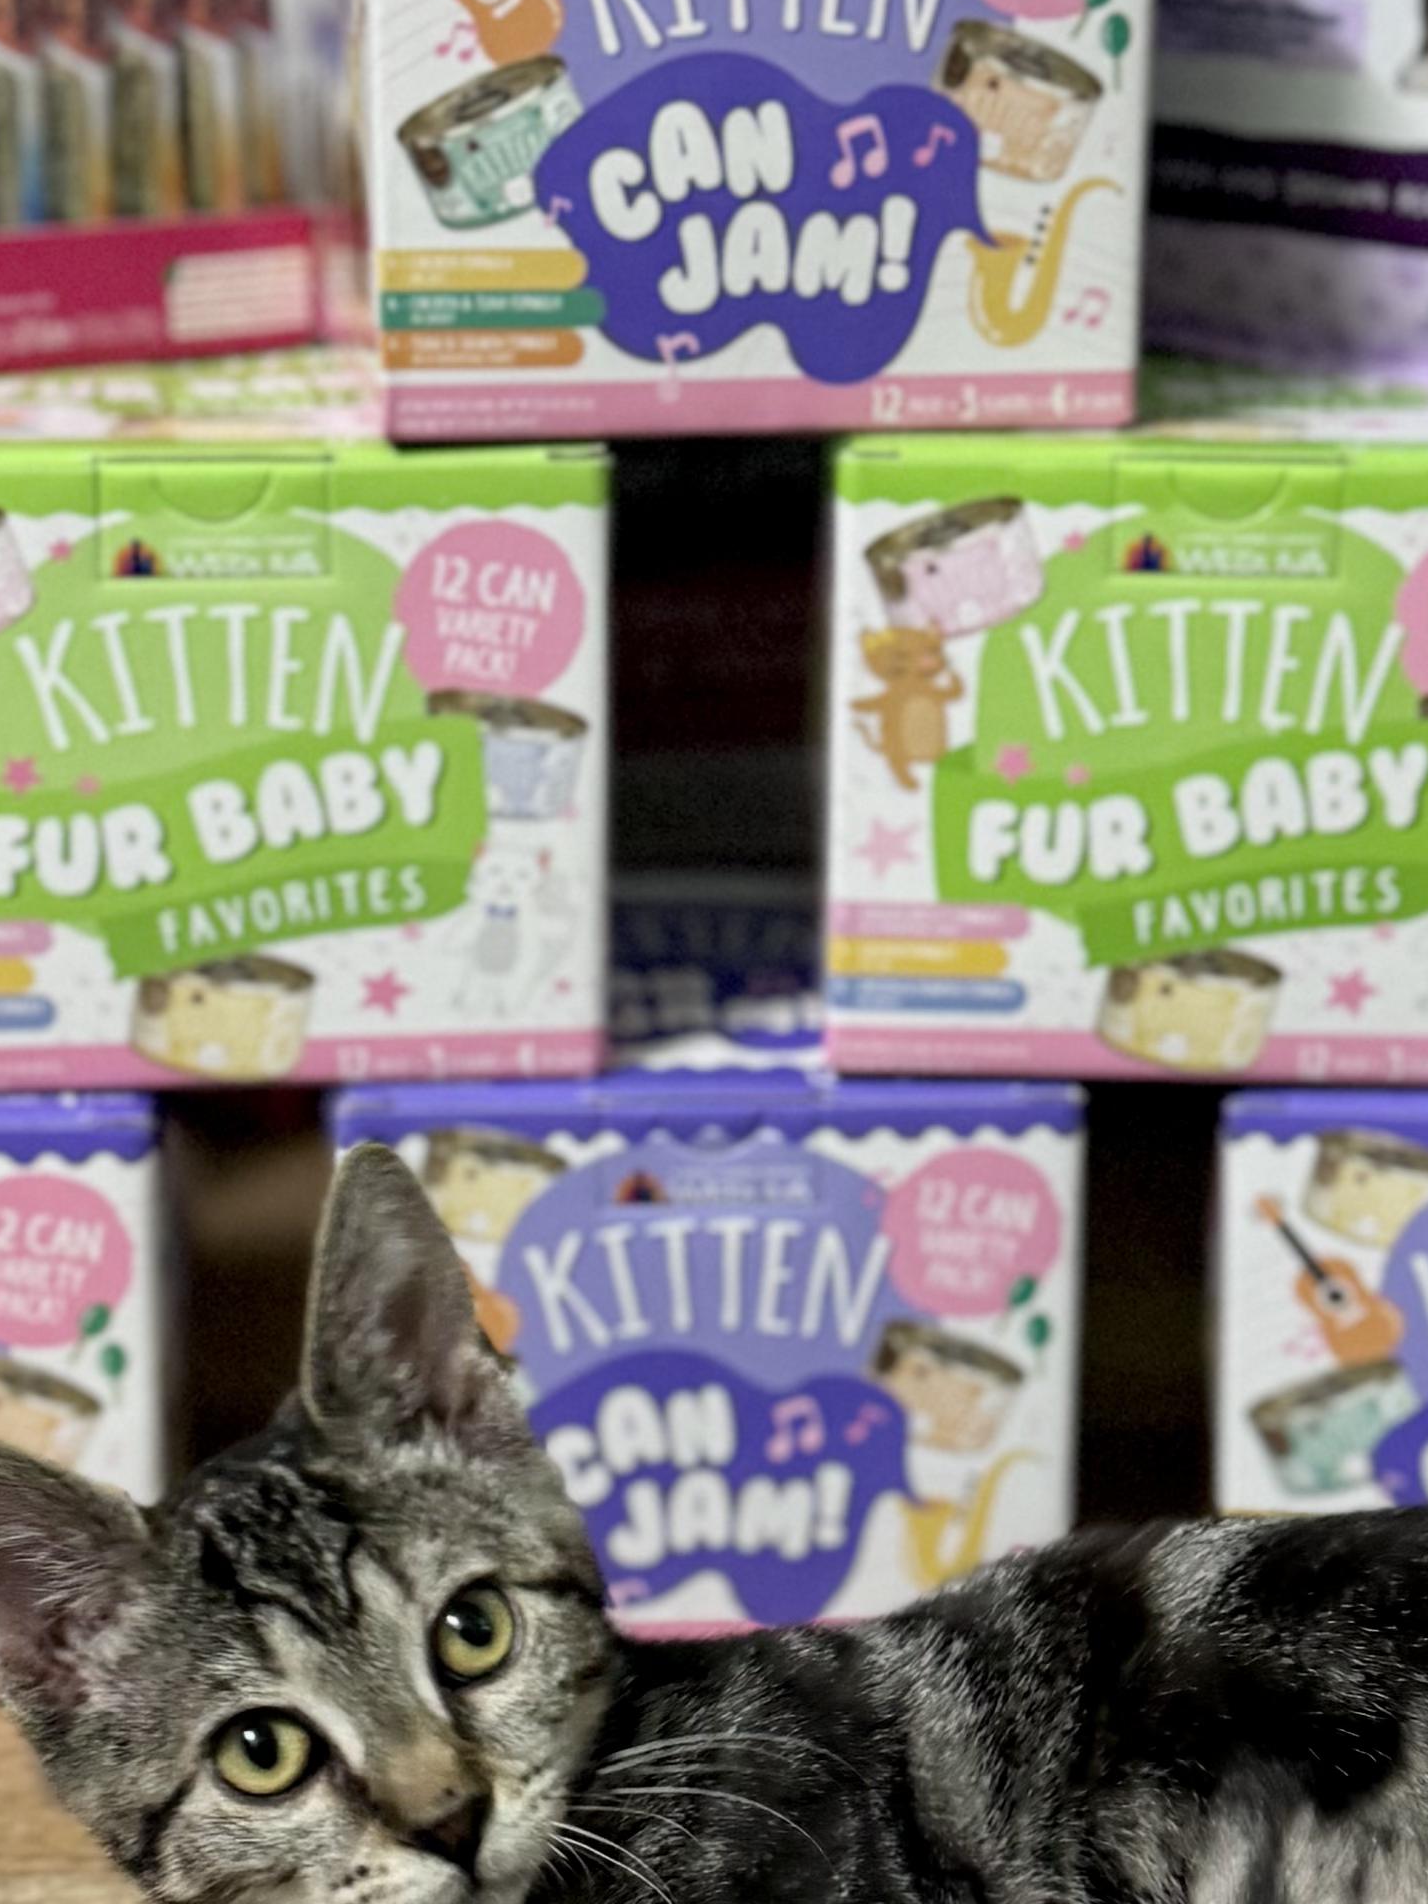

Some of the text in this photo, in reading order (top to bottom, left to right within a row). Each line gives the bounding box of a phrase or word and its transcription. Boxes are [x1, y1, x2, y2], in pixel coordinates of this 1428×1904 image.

[588, 99, 794, 241] CAN
[658, 194, 918, 314] JAM!
[431, 553, 558, 616] 12 CAN
[15, 605, 404, 751] KITTEN
[1020, 598, 1405, 746] KITTEN
[185, 738, 443, 864] BABY
[966, 793, 1154, 887] FUR
[158, 864, 426, 953] FAVORITES
[1133, 865, 1403, 946] FAVORITES
[24, 1212, 106, 1264] CAN
[524, 1216, 890, 1354] KITTEN
[545, 1384, 736, 1506] CAN
[607, 1462, 854, 1568] JAM!
